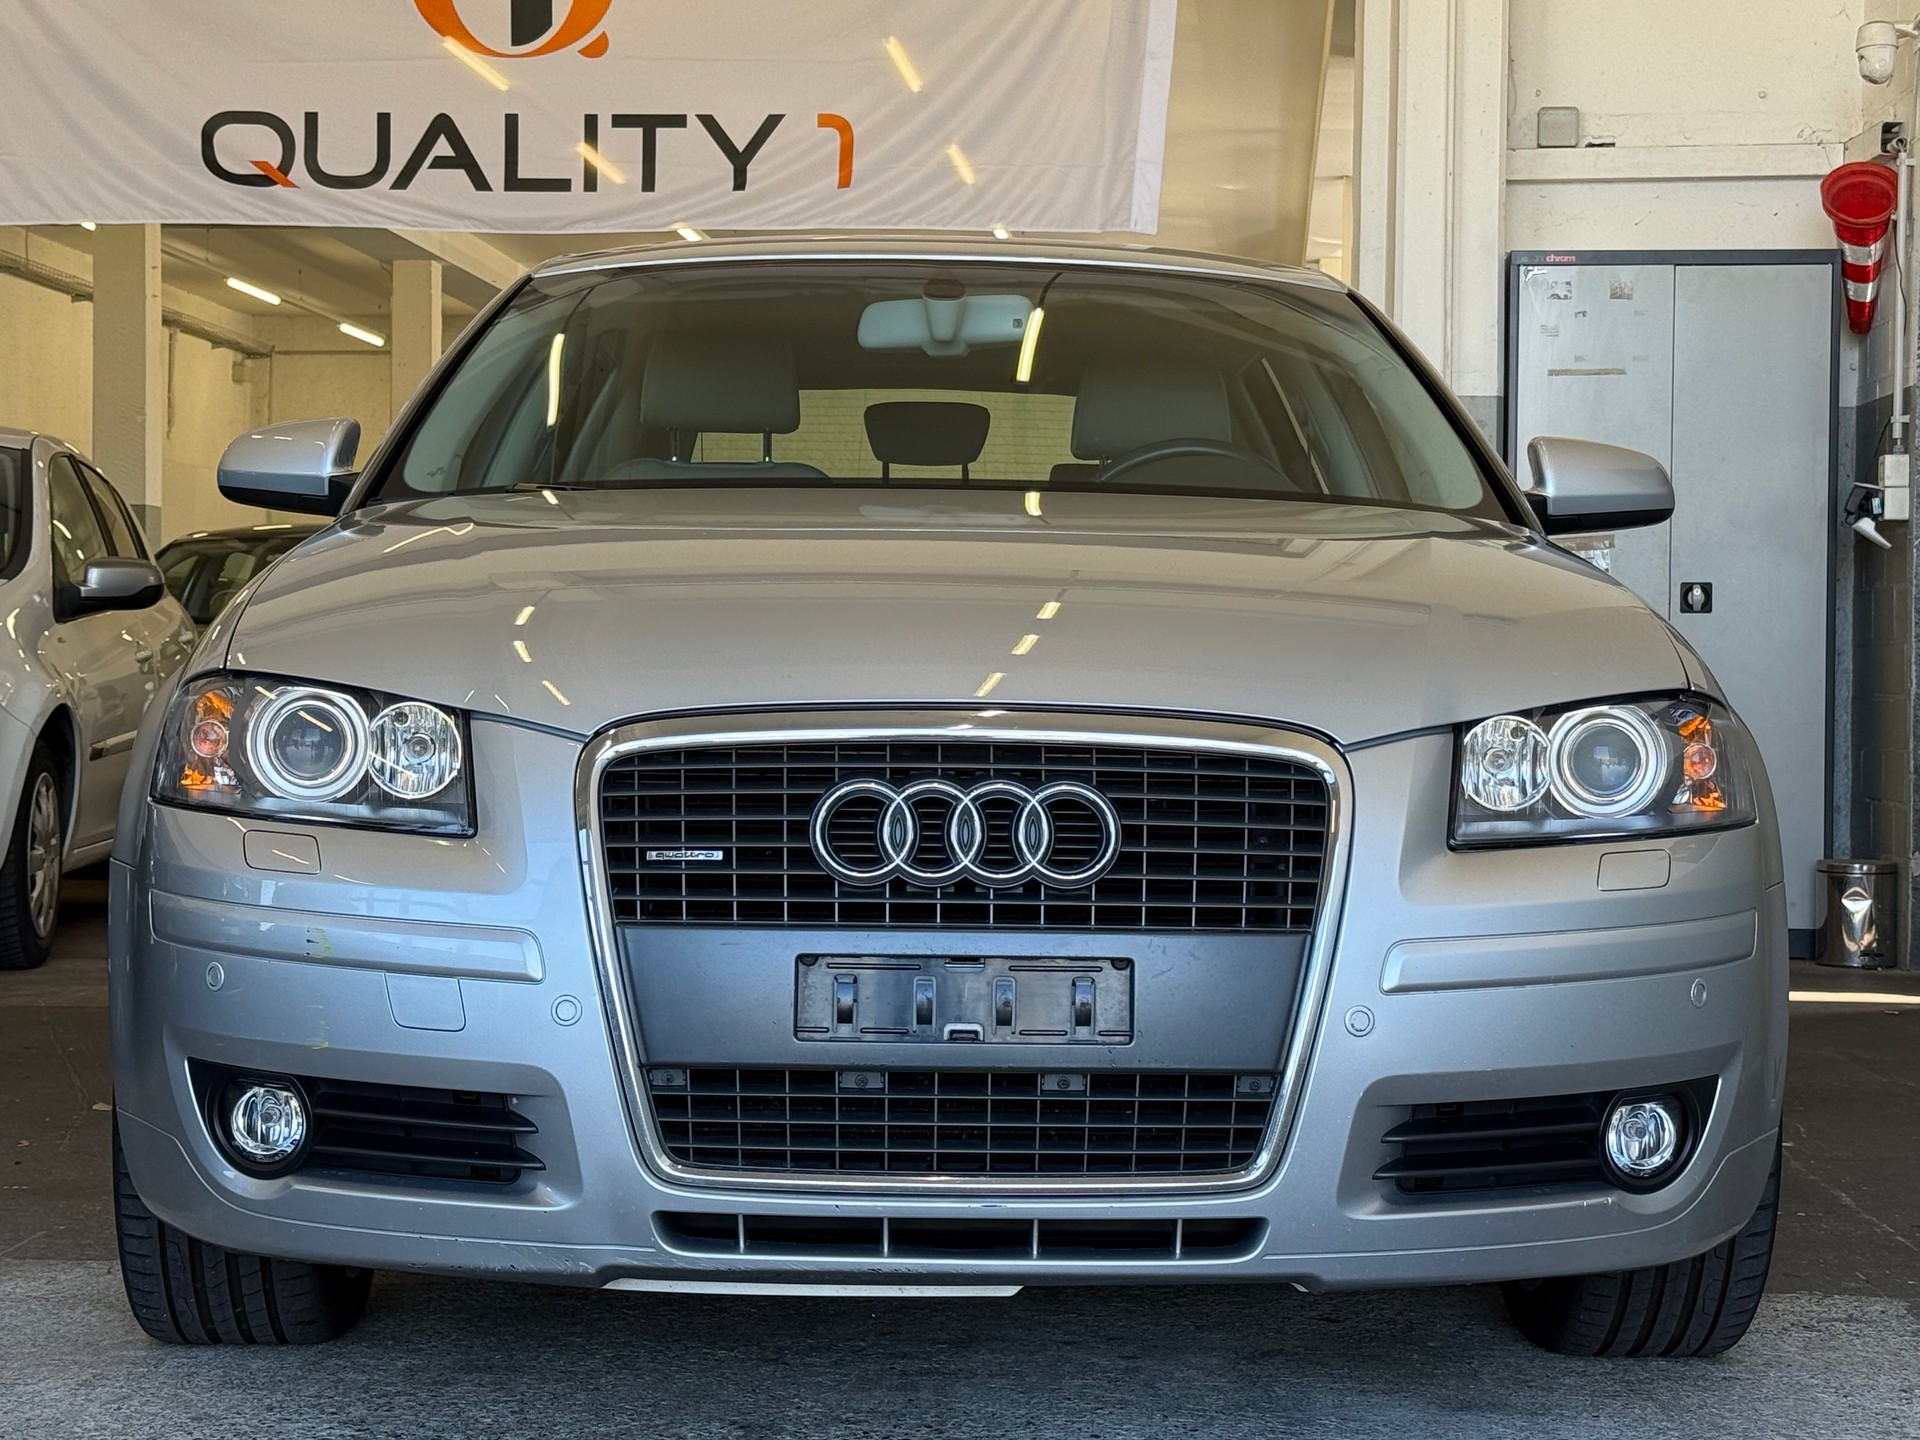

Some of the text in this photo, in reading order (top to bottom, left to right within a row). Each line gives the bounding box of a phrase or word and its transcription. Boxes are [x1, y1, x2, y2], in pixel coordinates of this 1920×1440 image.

[201, 110, 854, 192] QUALITY 1
[655, 851, 715, 860] quattro
